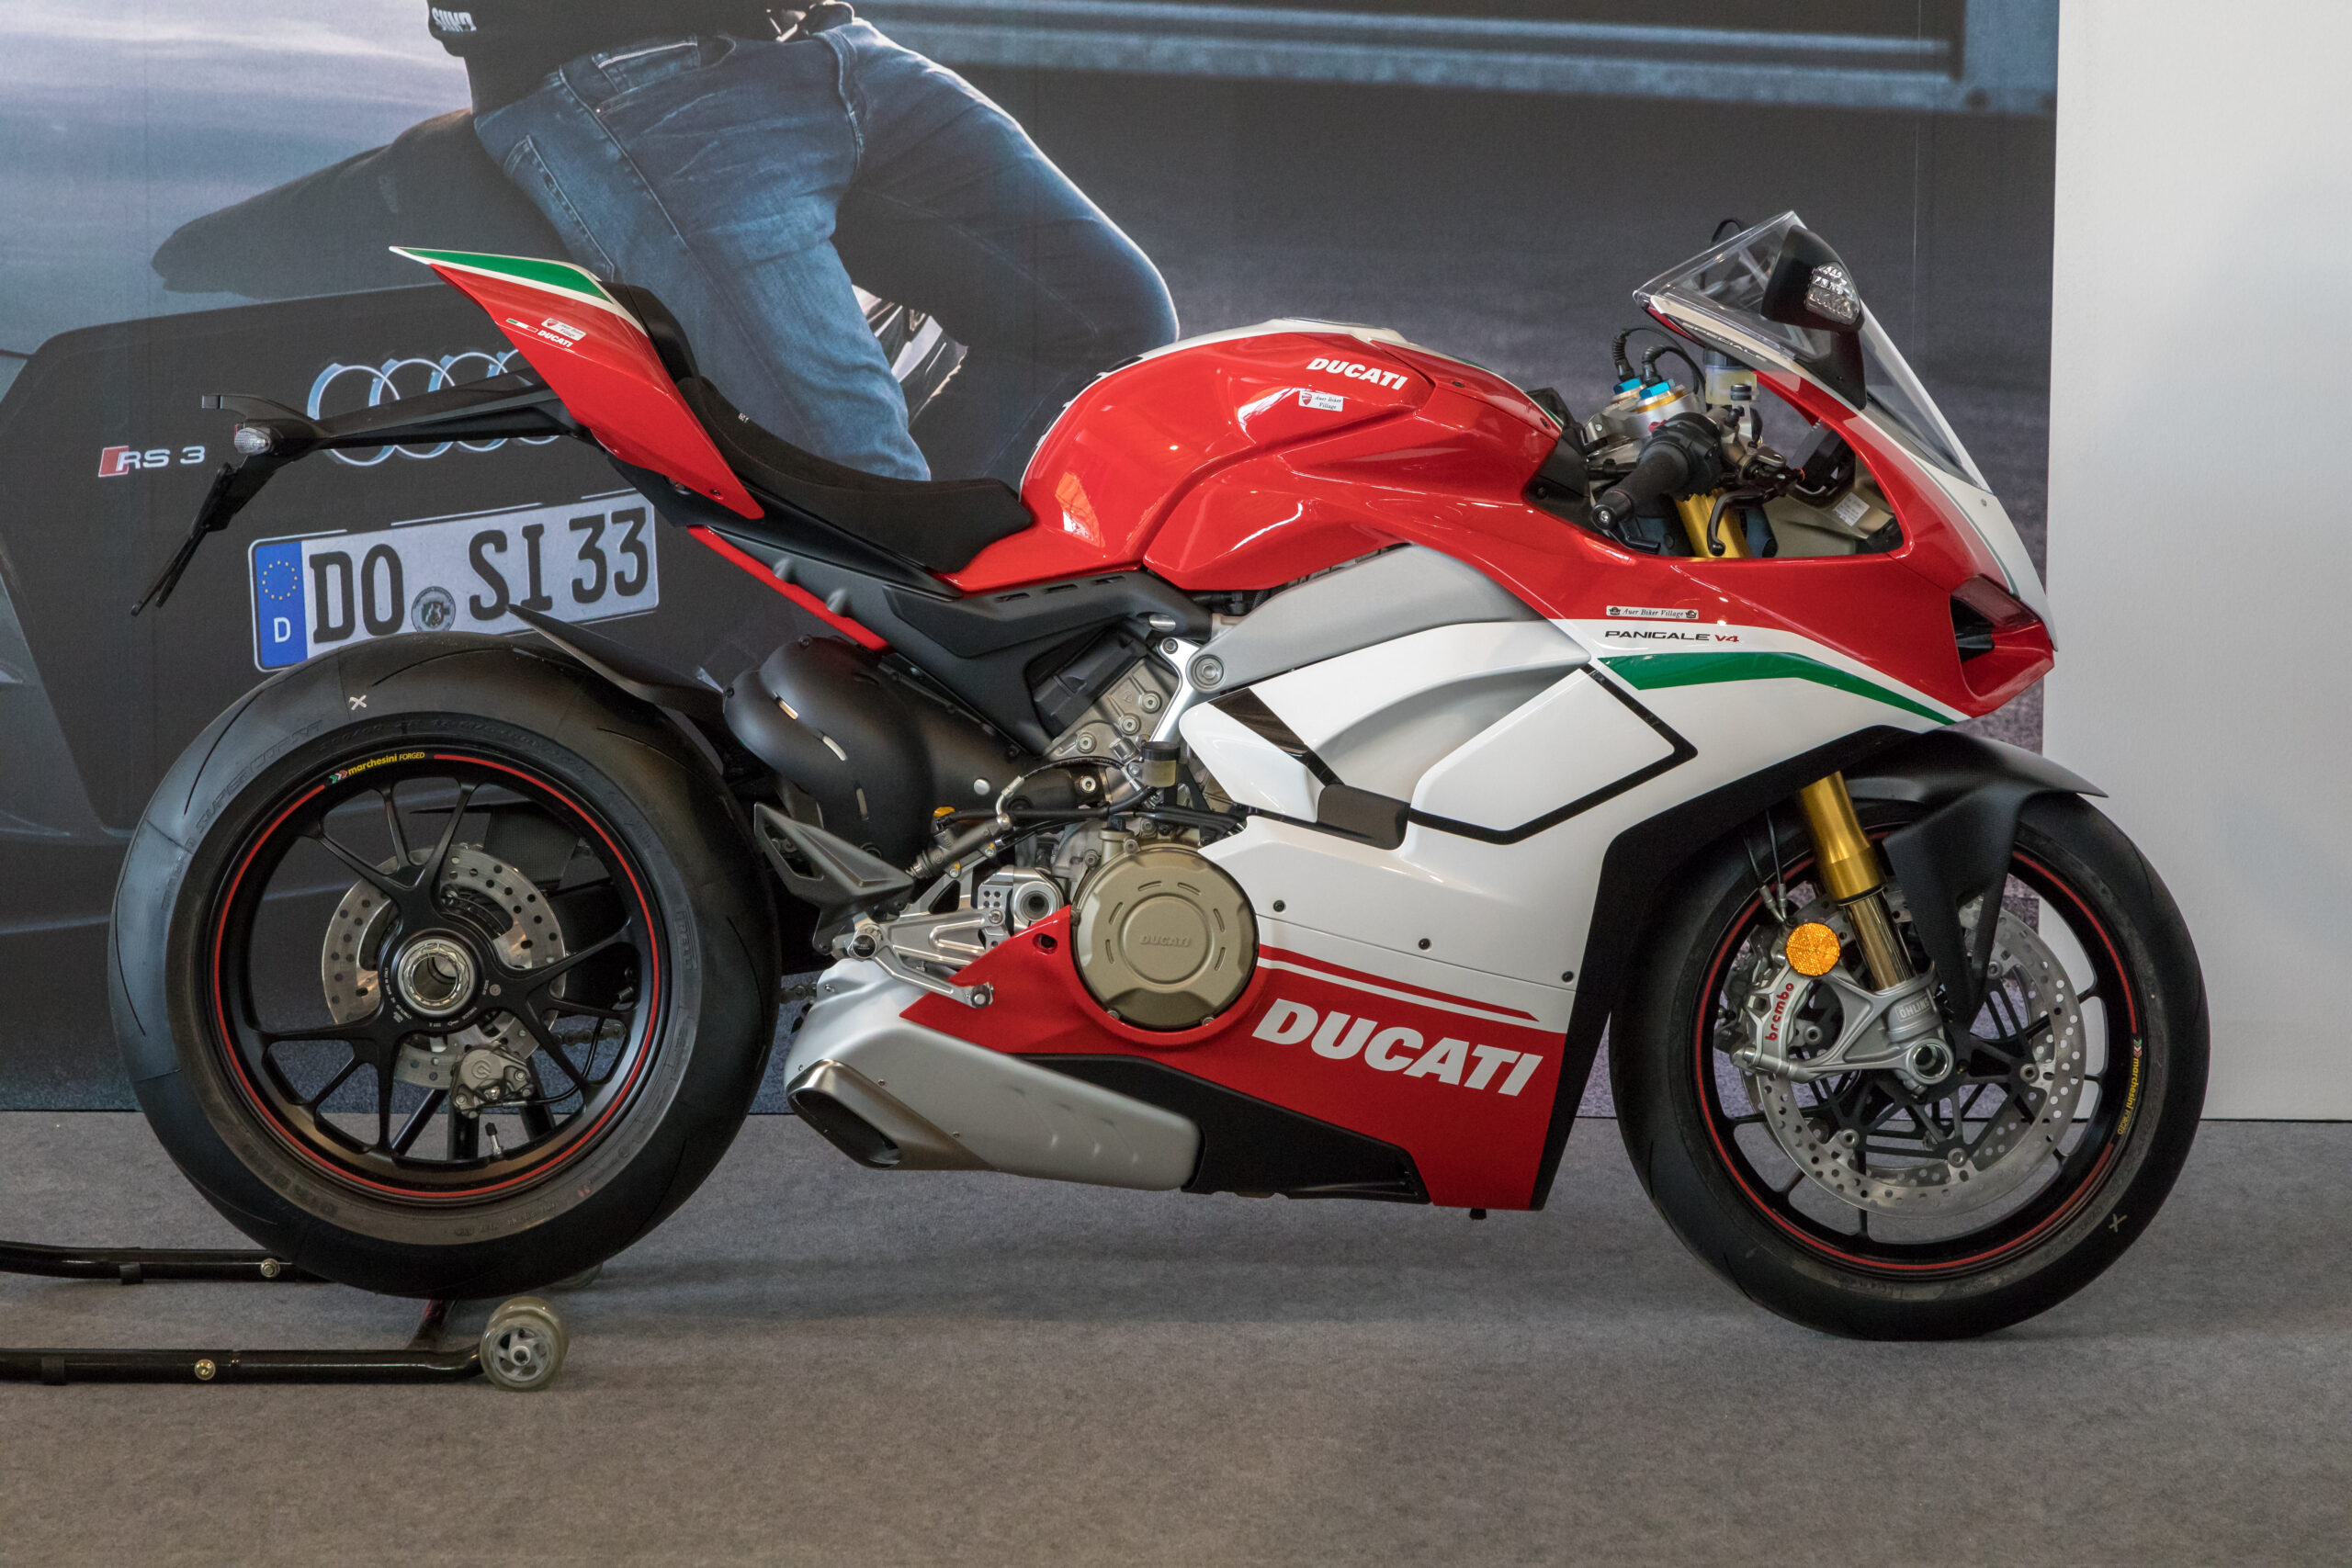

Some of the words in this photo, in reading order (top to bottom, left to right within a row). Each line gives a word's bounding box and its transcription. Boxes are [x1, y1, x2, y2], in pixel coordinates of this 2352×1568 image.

[537, 330, 573, 348] DUCATI
[1306, 357, 1408, 390] DUCATI
[115, 448, 171, 472] RS
[179, 446, 206, 465] 3
[309, 543, 405, 644] DO
[469, 523, 553, 622] SI
[568, 506, 649, 604] 33
[1660, 610, 1685, 619] Village
[273, 616, 291, 643] D
[1605, 630, 1711, 641] PANIGALE
[1714, 634, 1740, 643] V4
[348, 753, 397, 775] marchesini
[399, 751, 425, 761] FORGED
[1140, 935, 1191, 948] DUCATI
[1765, 982, 1794, 1041] brembo
[1251, 998, 1544, 1097] DUCATI
[2126, 1057, 2140, 1110] marchesini
[2117, 1108, 2132, 1135] FORGED
